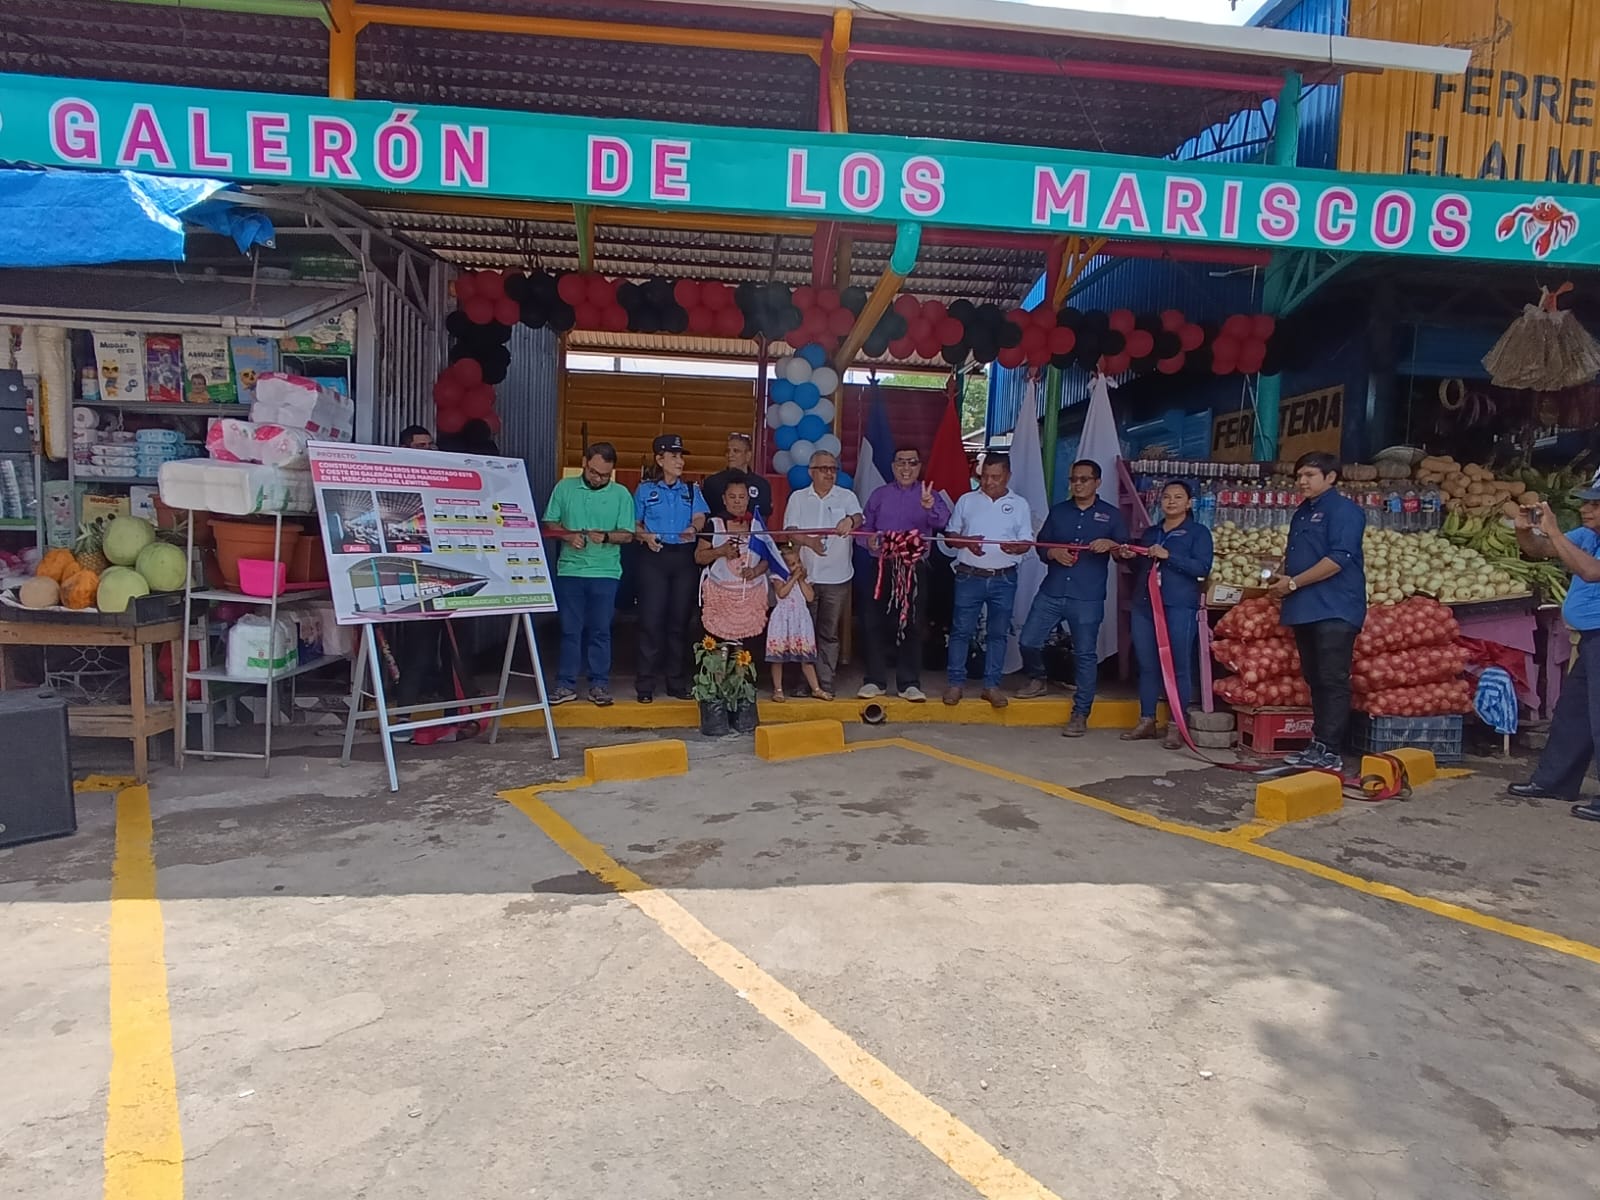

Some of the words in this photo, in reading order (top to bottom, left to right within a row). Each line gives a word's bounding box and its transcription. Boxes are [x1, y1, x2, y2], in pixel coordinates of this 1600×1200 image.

[1432, 66, 1596, 127] FERRE
[48, 97, 490, 188] GALERÓN
[587, 135, 691, 201] DE
[786, 148, 945, 216] LOS
[1032, 165, 1472, 253] MARISCOS
[1403, 131, 1463, 178] EL
[318, 462, 373, 471] CONSTRUCCIÓN
[429, 469, 458, 477] COSTADO
[417, 474, 449, 482] MARISCOS
